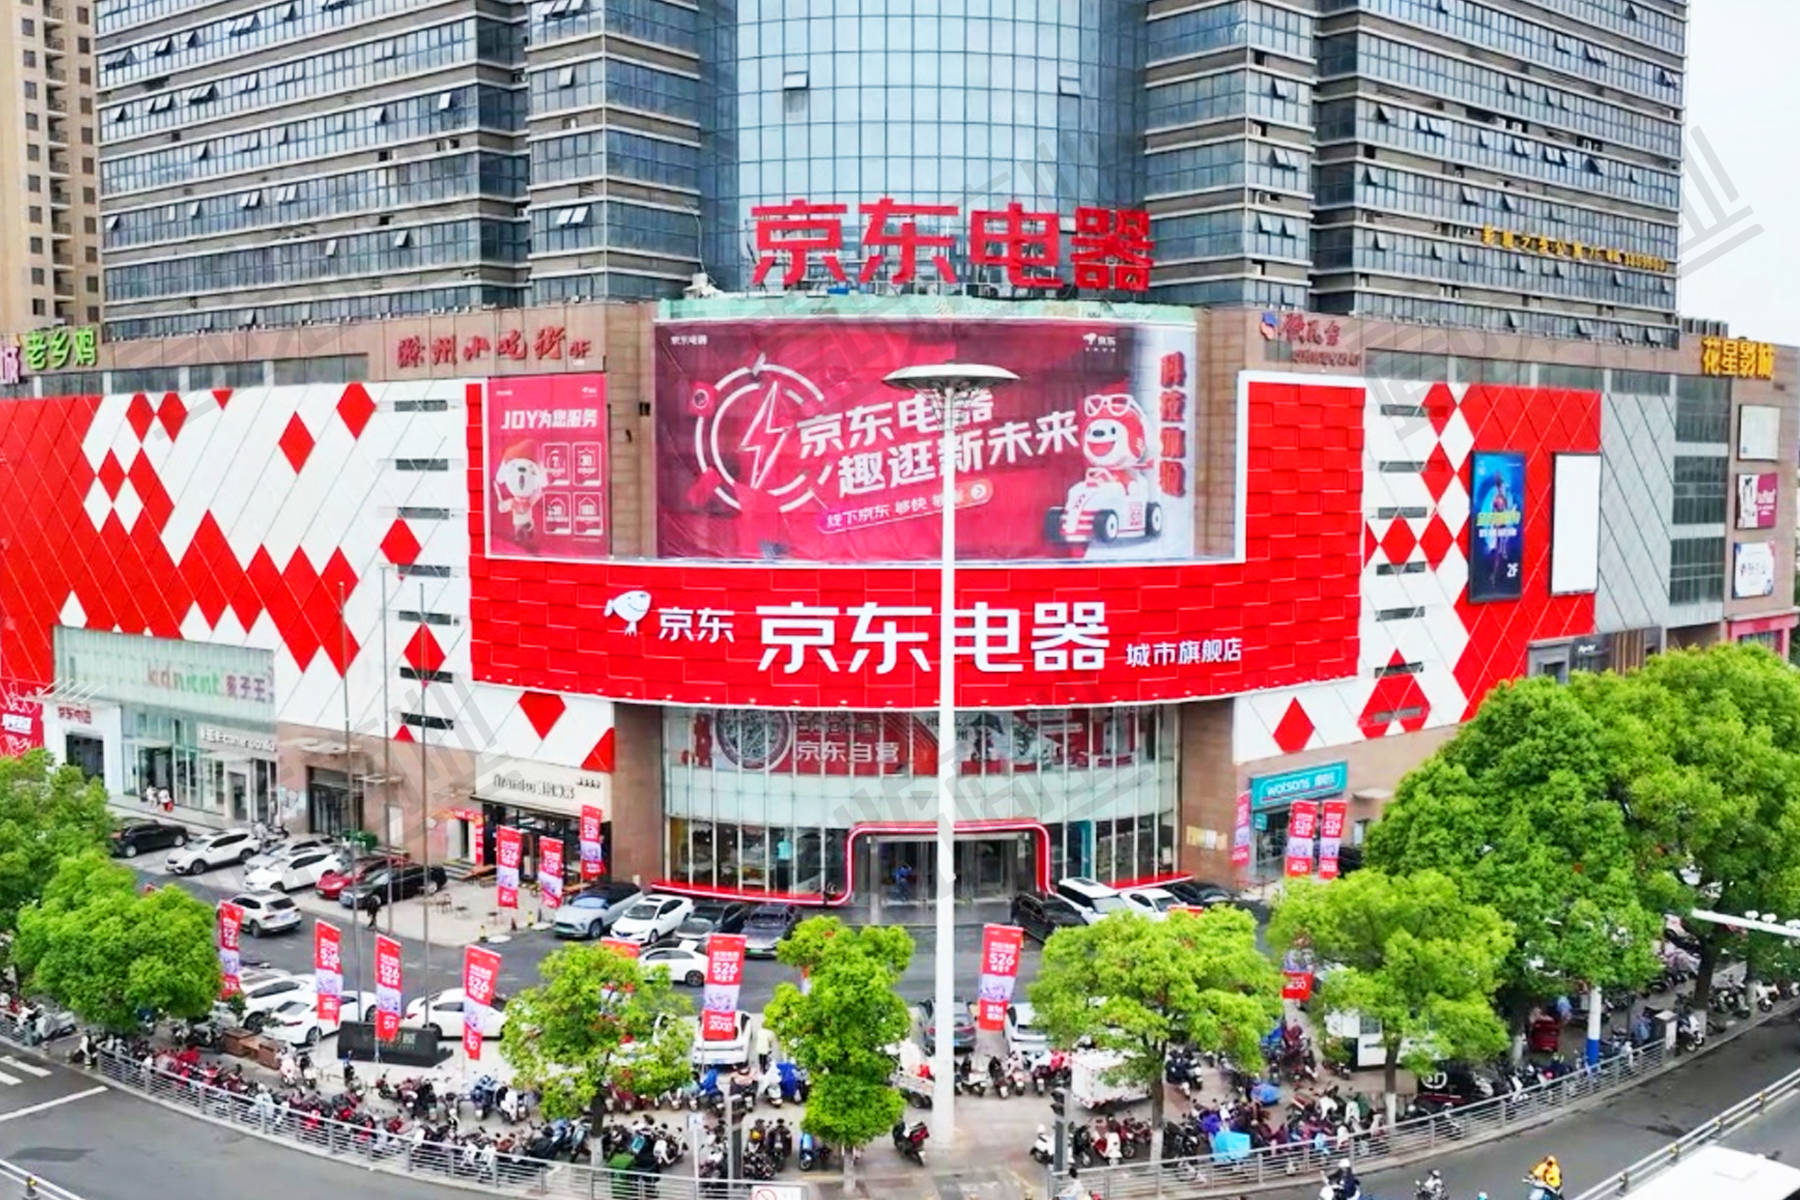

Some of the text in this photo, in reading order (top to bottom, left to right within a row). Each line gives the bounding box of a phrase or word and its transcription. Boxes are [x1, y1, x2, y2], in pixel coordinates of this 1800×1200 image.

[751, 198, 1154, 291] 京东电器
[27, 326, 96, 370] 老乡鸡
[398, 326, 567, 369] 滁州小吃街
[501, 408, 598, 430] JOY为您服务
[797, 388, 993, 459] 京东电器
[838, 410, 1080, 498] 趣逛新未来
[658, 601, 1243, 674] 京东 京东电器 城市旗舰店
[797, 740, 900, 763] 京东自营
[380, 963, 400, 979] 526
[712, 961, 738, 976] 526
[989, 951, 1016, 967] 526
[467, 975, 490, 994] 526
